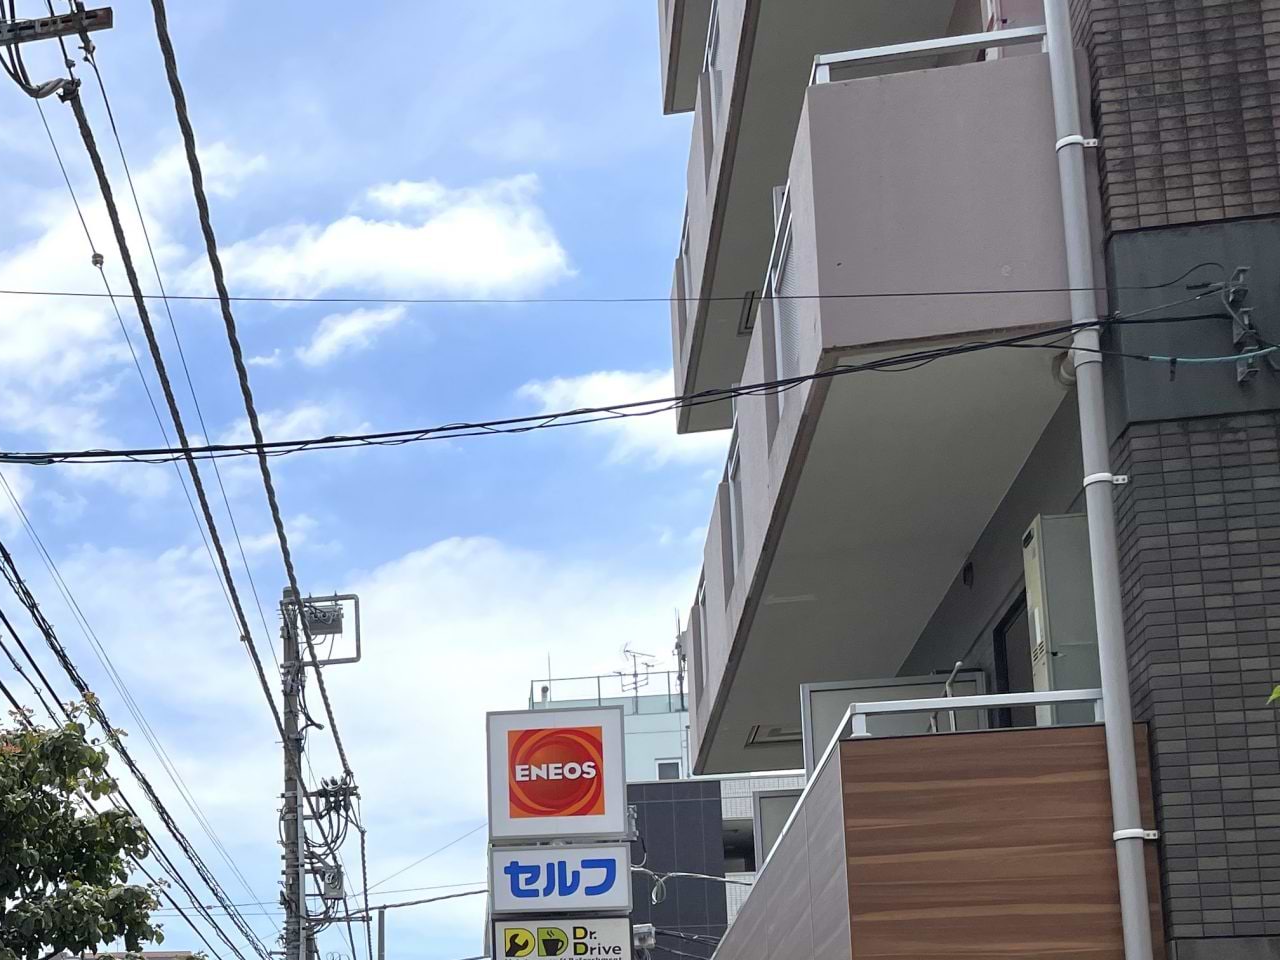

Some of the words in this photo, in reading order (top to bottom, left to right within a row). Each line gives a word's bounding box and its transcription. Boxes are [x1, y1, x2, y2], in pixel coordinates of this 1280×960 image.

[515, 760, 597, 782] ENEOS
[504, 858, 617, 898] セルフ
[573, 926, 597, 940] Dr.
[573, 942, 622, 956] Drive
